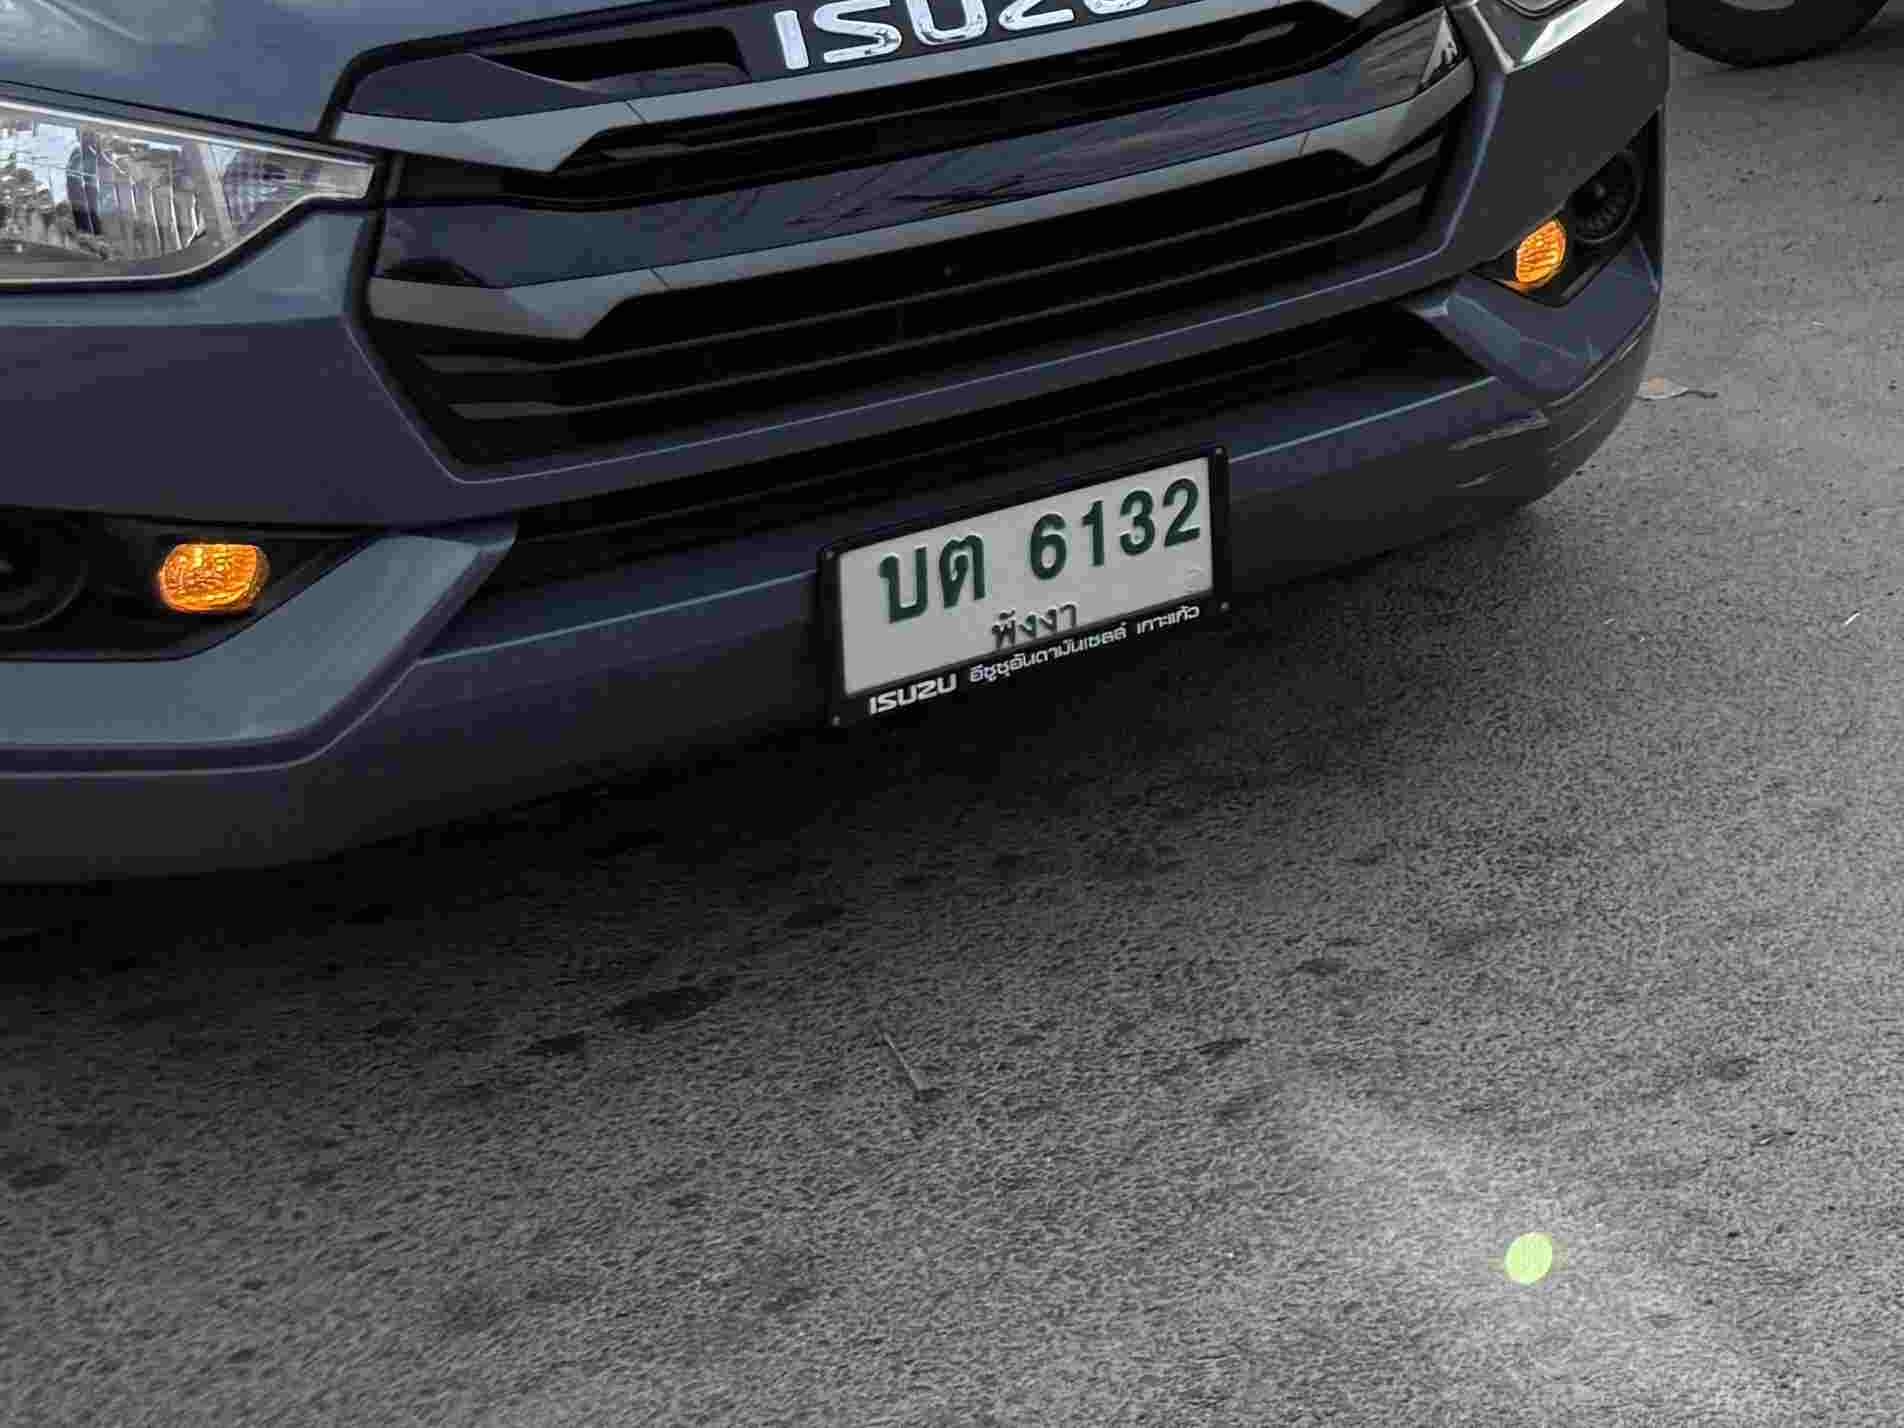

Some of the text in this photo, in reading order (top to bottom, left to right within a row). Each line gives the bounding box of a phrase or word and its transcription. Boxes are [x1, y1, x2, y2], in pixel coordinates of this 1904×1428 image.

[1028, 477, 1202, 581] 6132
[990, 600, 1080, 650] พังงา
[868, 672, 958, 716] ISUZU
